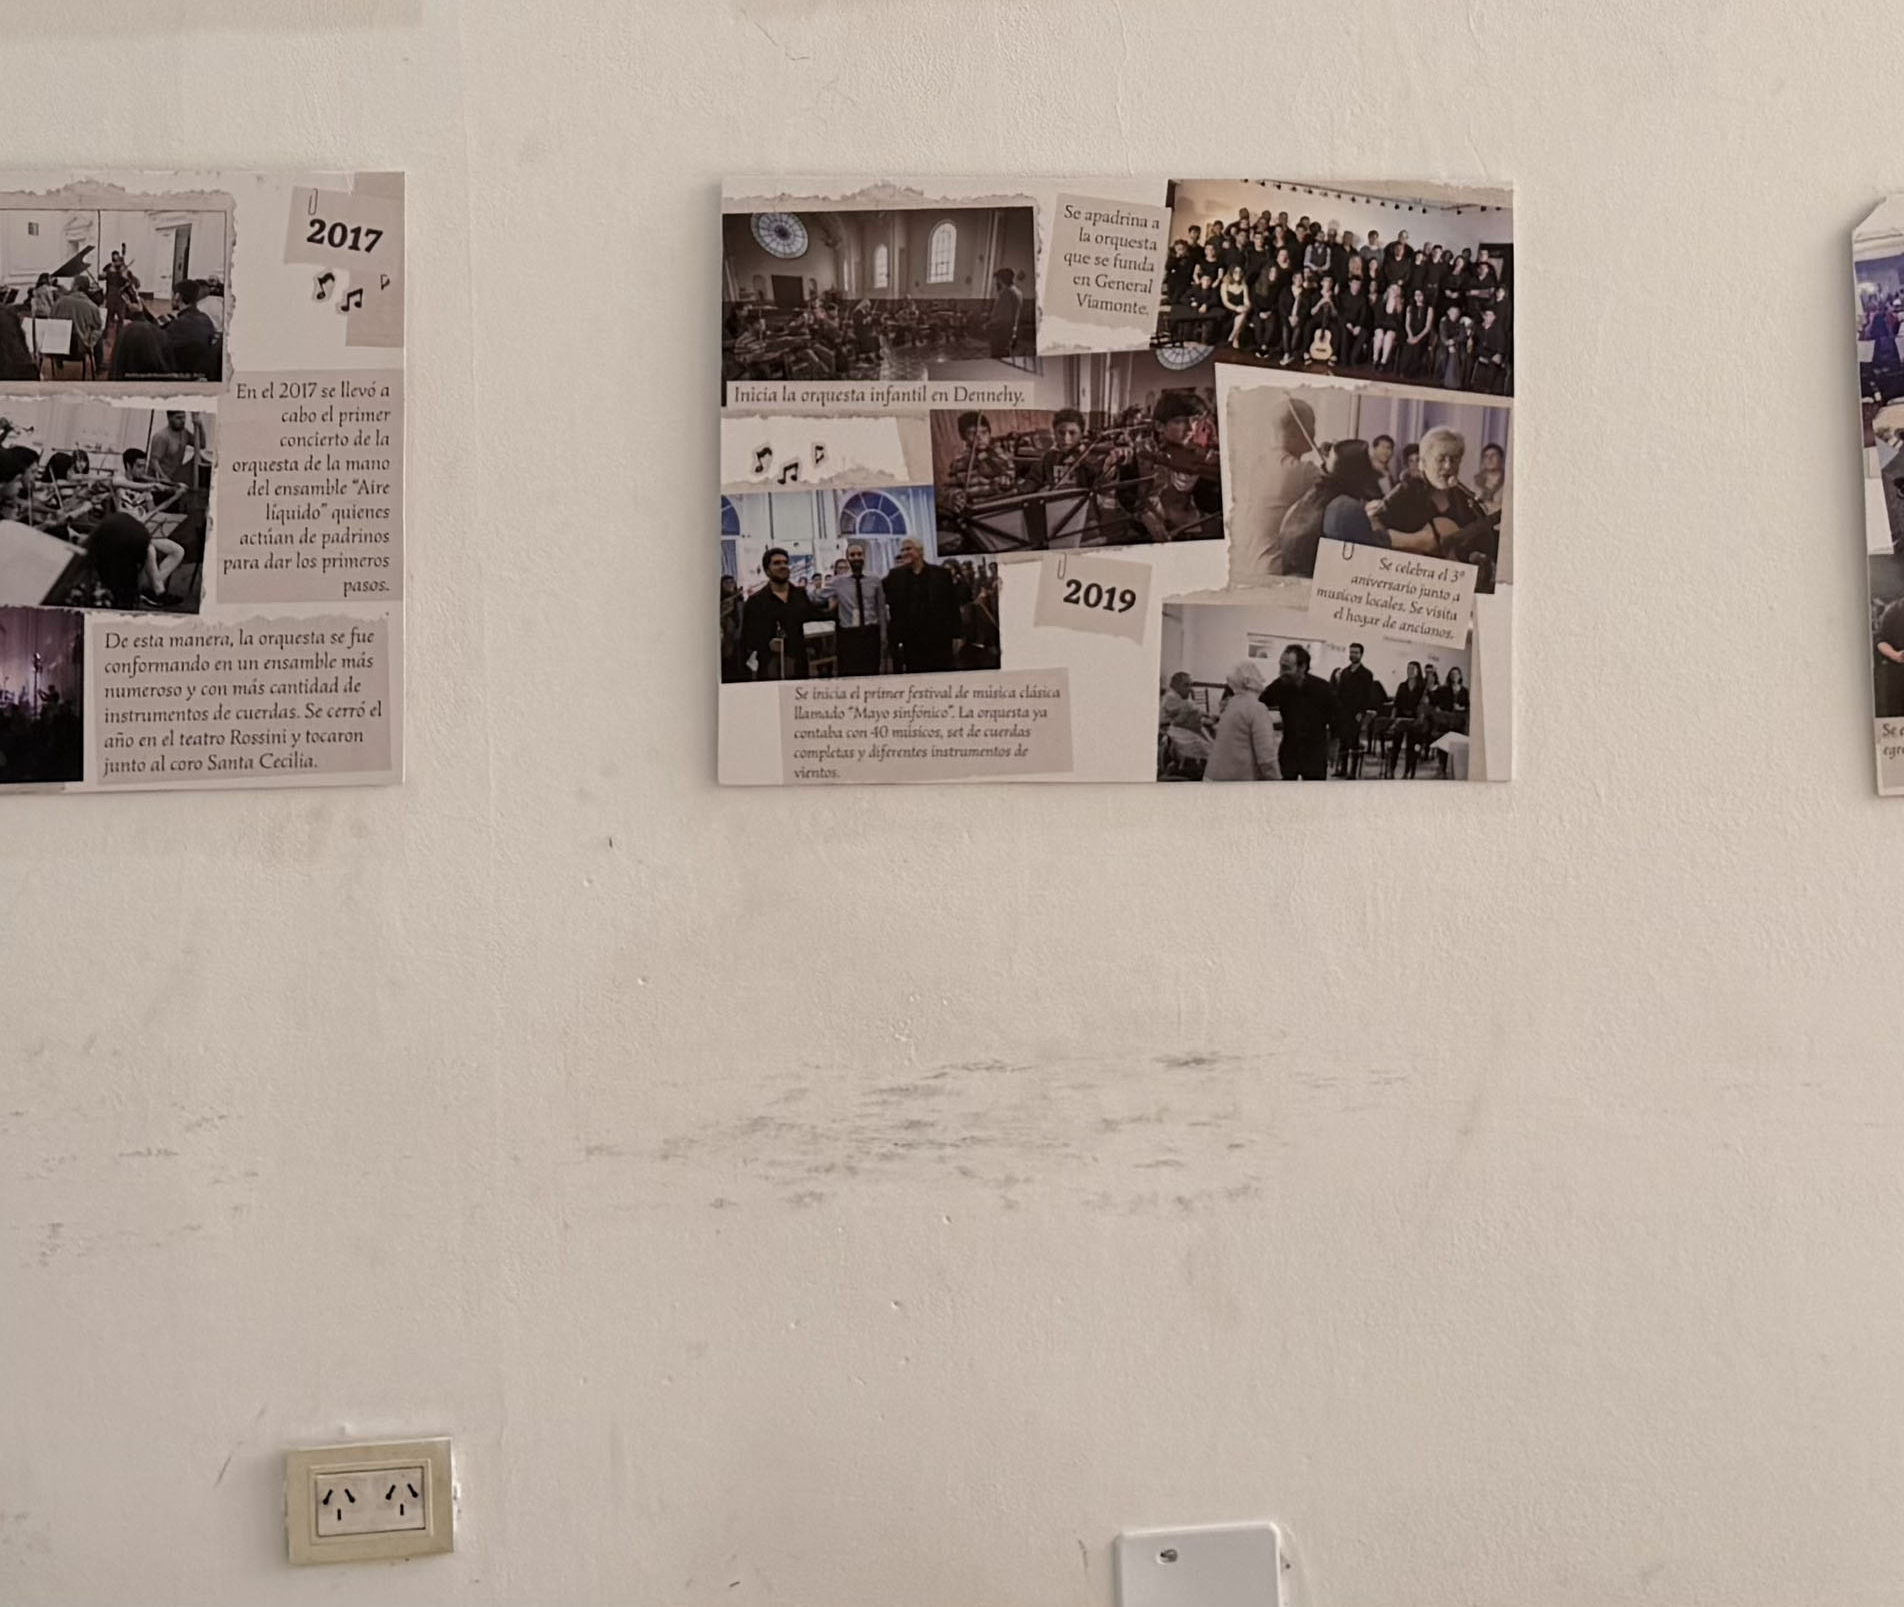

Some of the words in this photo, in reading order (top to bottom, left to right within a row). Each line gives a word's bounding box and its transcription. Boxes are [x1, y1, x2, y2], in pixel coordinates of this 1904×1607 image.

[1063, 204, 1082, 220] Se
[1084, 209, 1148, 229] apadrina
[1151, 219, 1160, 230] a
[306, 218, 384, 254] 2017
[1078, 226, 1091, 243] la
[1094, 234, 1158, 252] orquesta
[1063, 252, 1091, 267] que
[1093, 255, 1110, 267] se
[1113, 252, 1155, 273] funda
[1072, 275, 1091, 287] en
[1094, 273, 1154, 295] General
[1076, 291, 1149, 316] Viamonte.
[236, 382, 257, 400] En
[261, 381, 274, 400] el
[278, 381, 318, 399] 2017
[320, 387, 336, 399] se
[341, 380, 377, 399] llevó
[380, 386, 390, 398] a
[735, 385, 778, 403] Inicia
[782, 384, 797, 403] la
[800, 388, 866, 407] orquesta
[870, 384, 927, 408] infantil
[931, 391, 949, 403] en
[953, 384, 1025, 407] Dennehy.
[281, 404, 317, 424] cabo
[321, 404, 334, 423] el
[338, 406, 391, 428] primer
[279, 431, 349, 448] concierto
[353, 428, 371, 447] de
[375, 429, 390, 447] la
[1062, 578, 1137, 614] 2019
